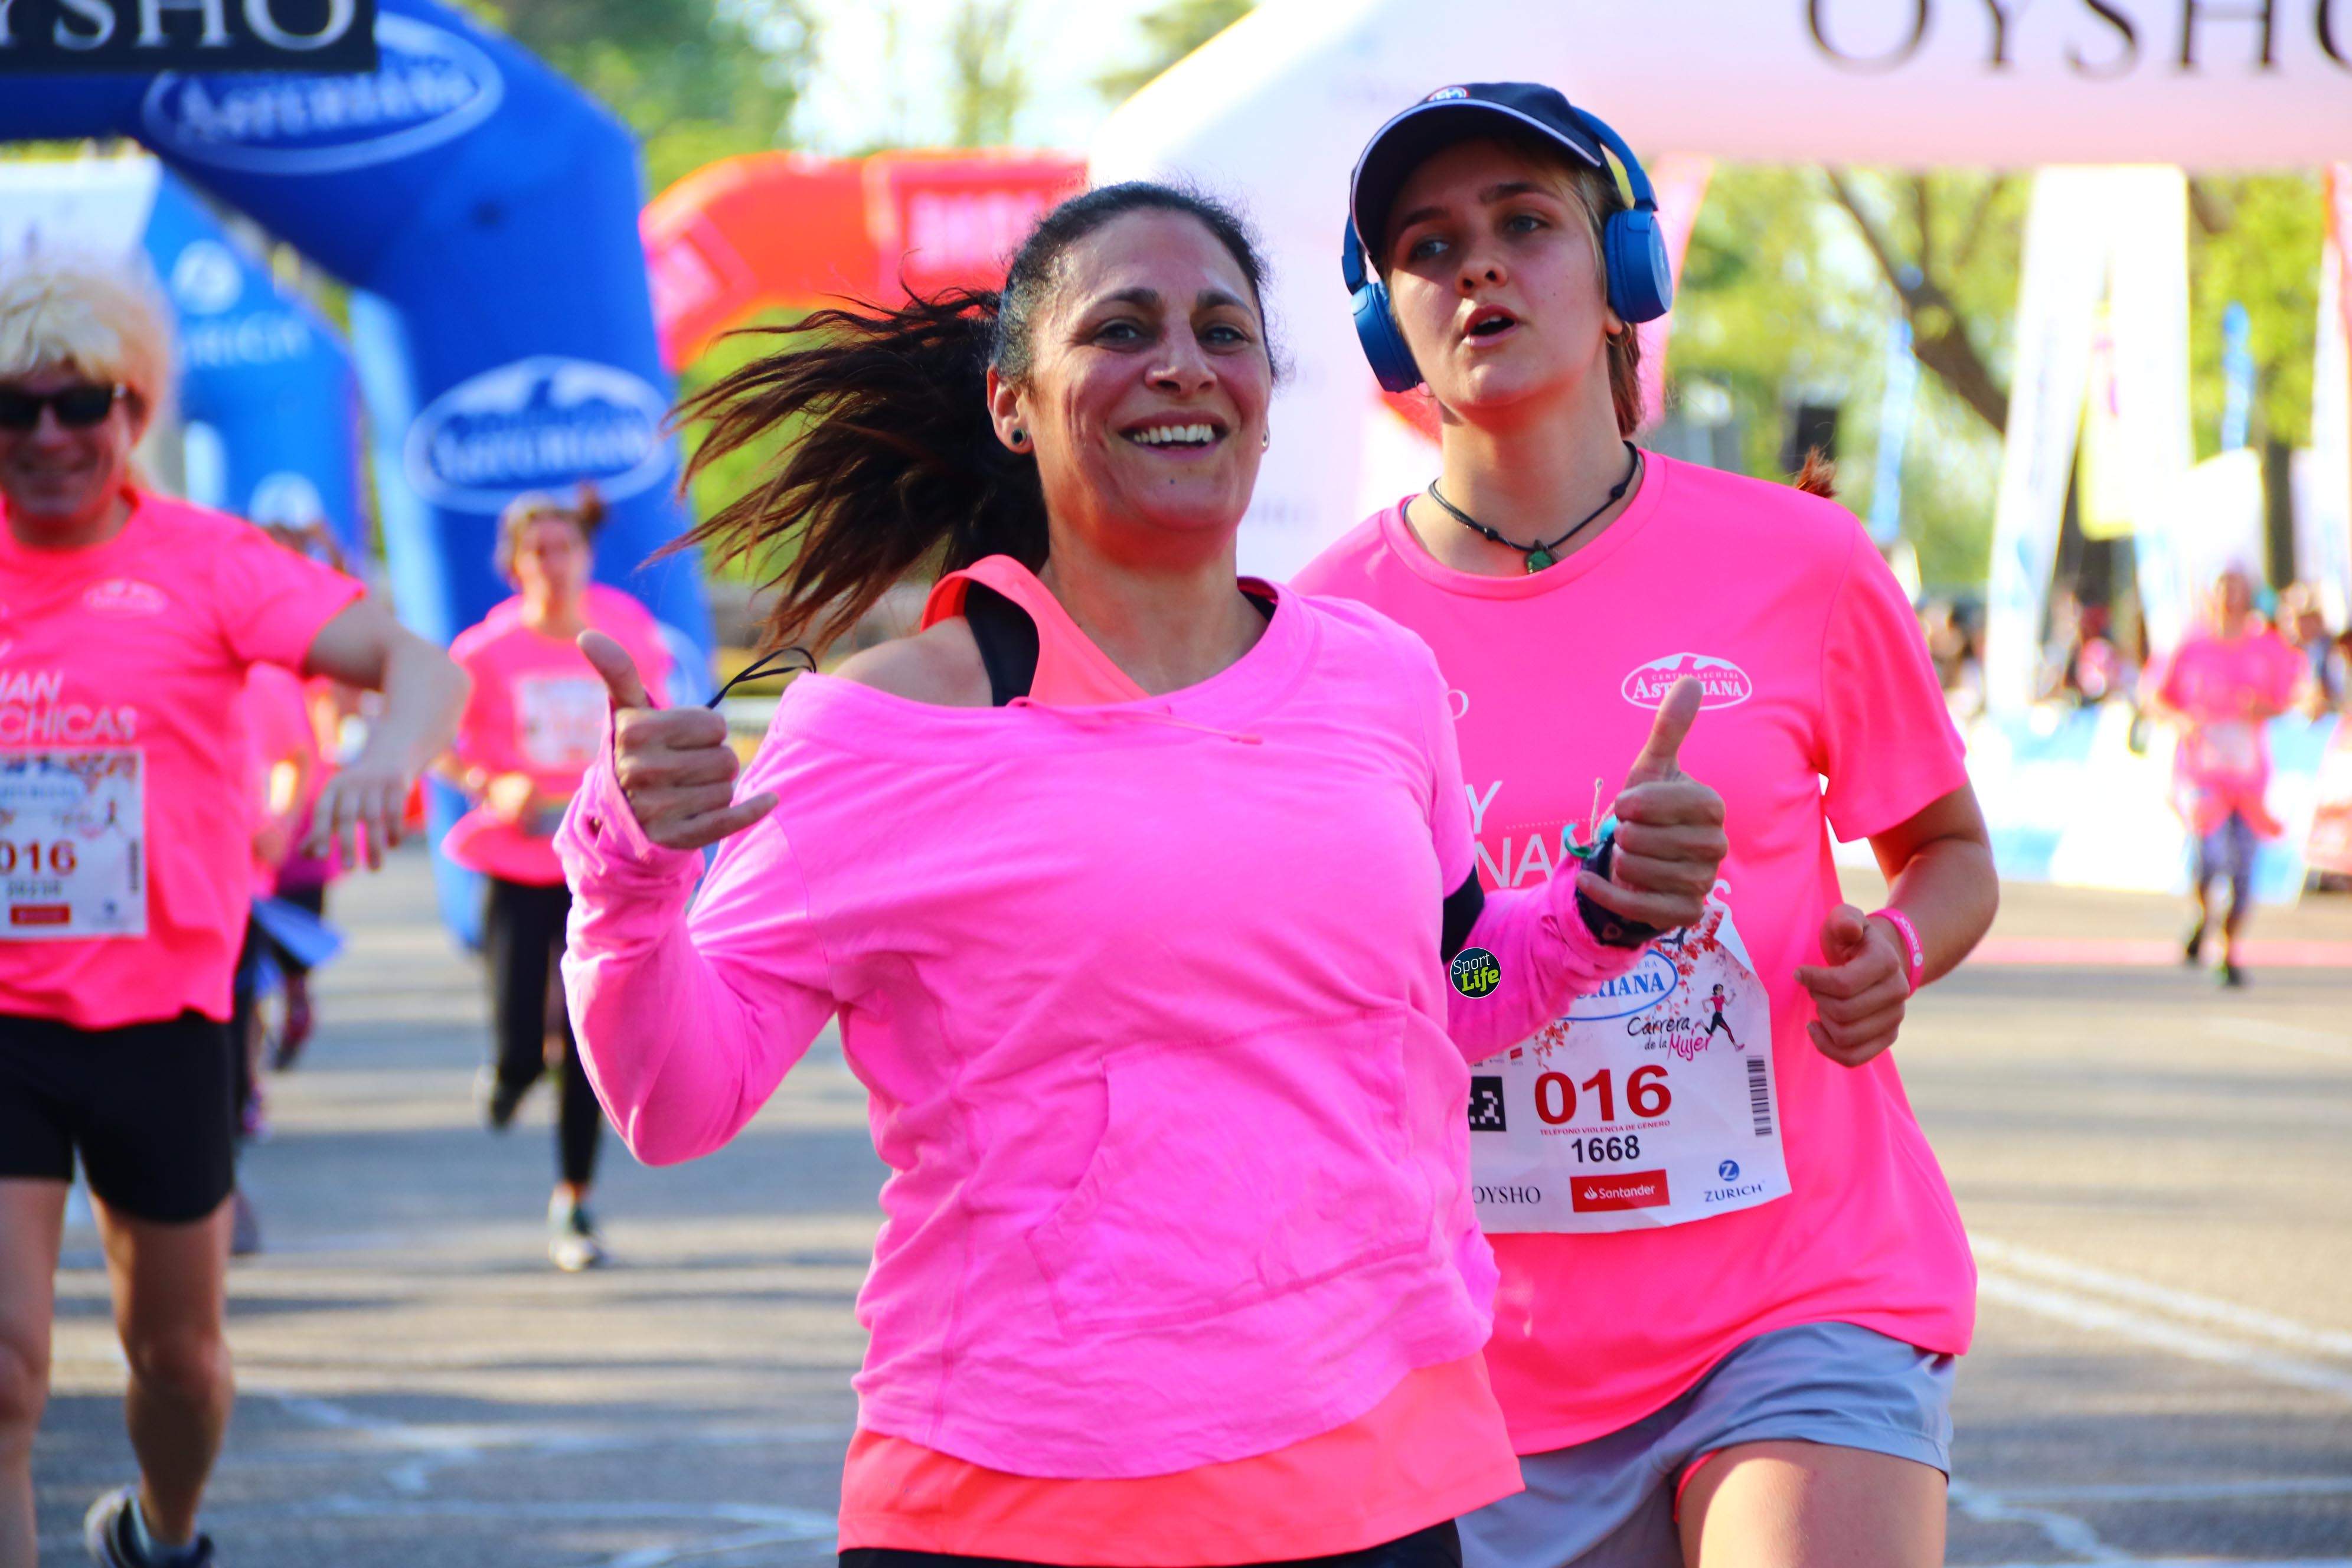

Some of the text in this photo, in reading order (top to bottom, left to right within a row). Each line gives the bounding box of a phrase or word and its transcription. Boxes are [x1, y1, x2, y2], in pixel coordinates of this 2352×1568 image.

[1627, 1017, 1690, 1037] Carrera
[1644, 1036, 1657, 1050] de
[1667, 1028, 1713, 1061] Mujer
[1535, 1064, 1672, 1125] 016
[1625, 1123, 1636, 1131] DE
[1571, 1135, 1640, 1163] 1668
[1472, 1185, 1541, 1204] OYSHO
[1598, 1184, 1655, 1200] Santander
[1704, 1184, 1763, 1203] ZURICH
